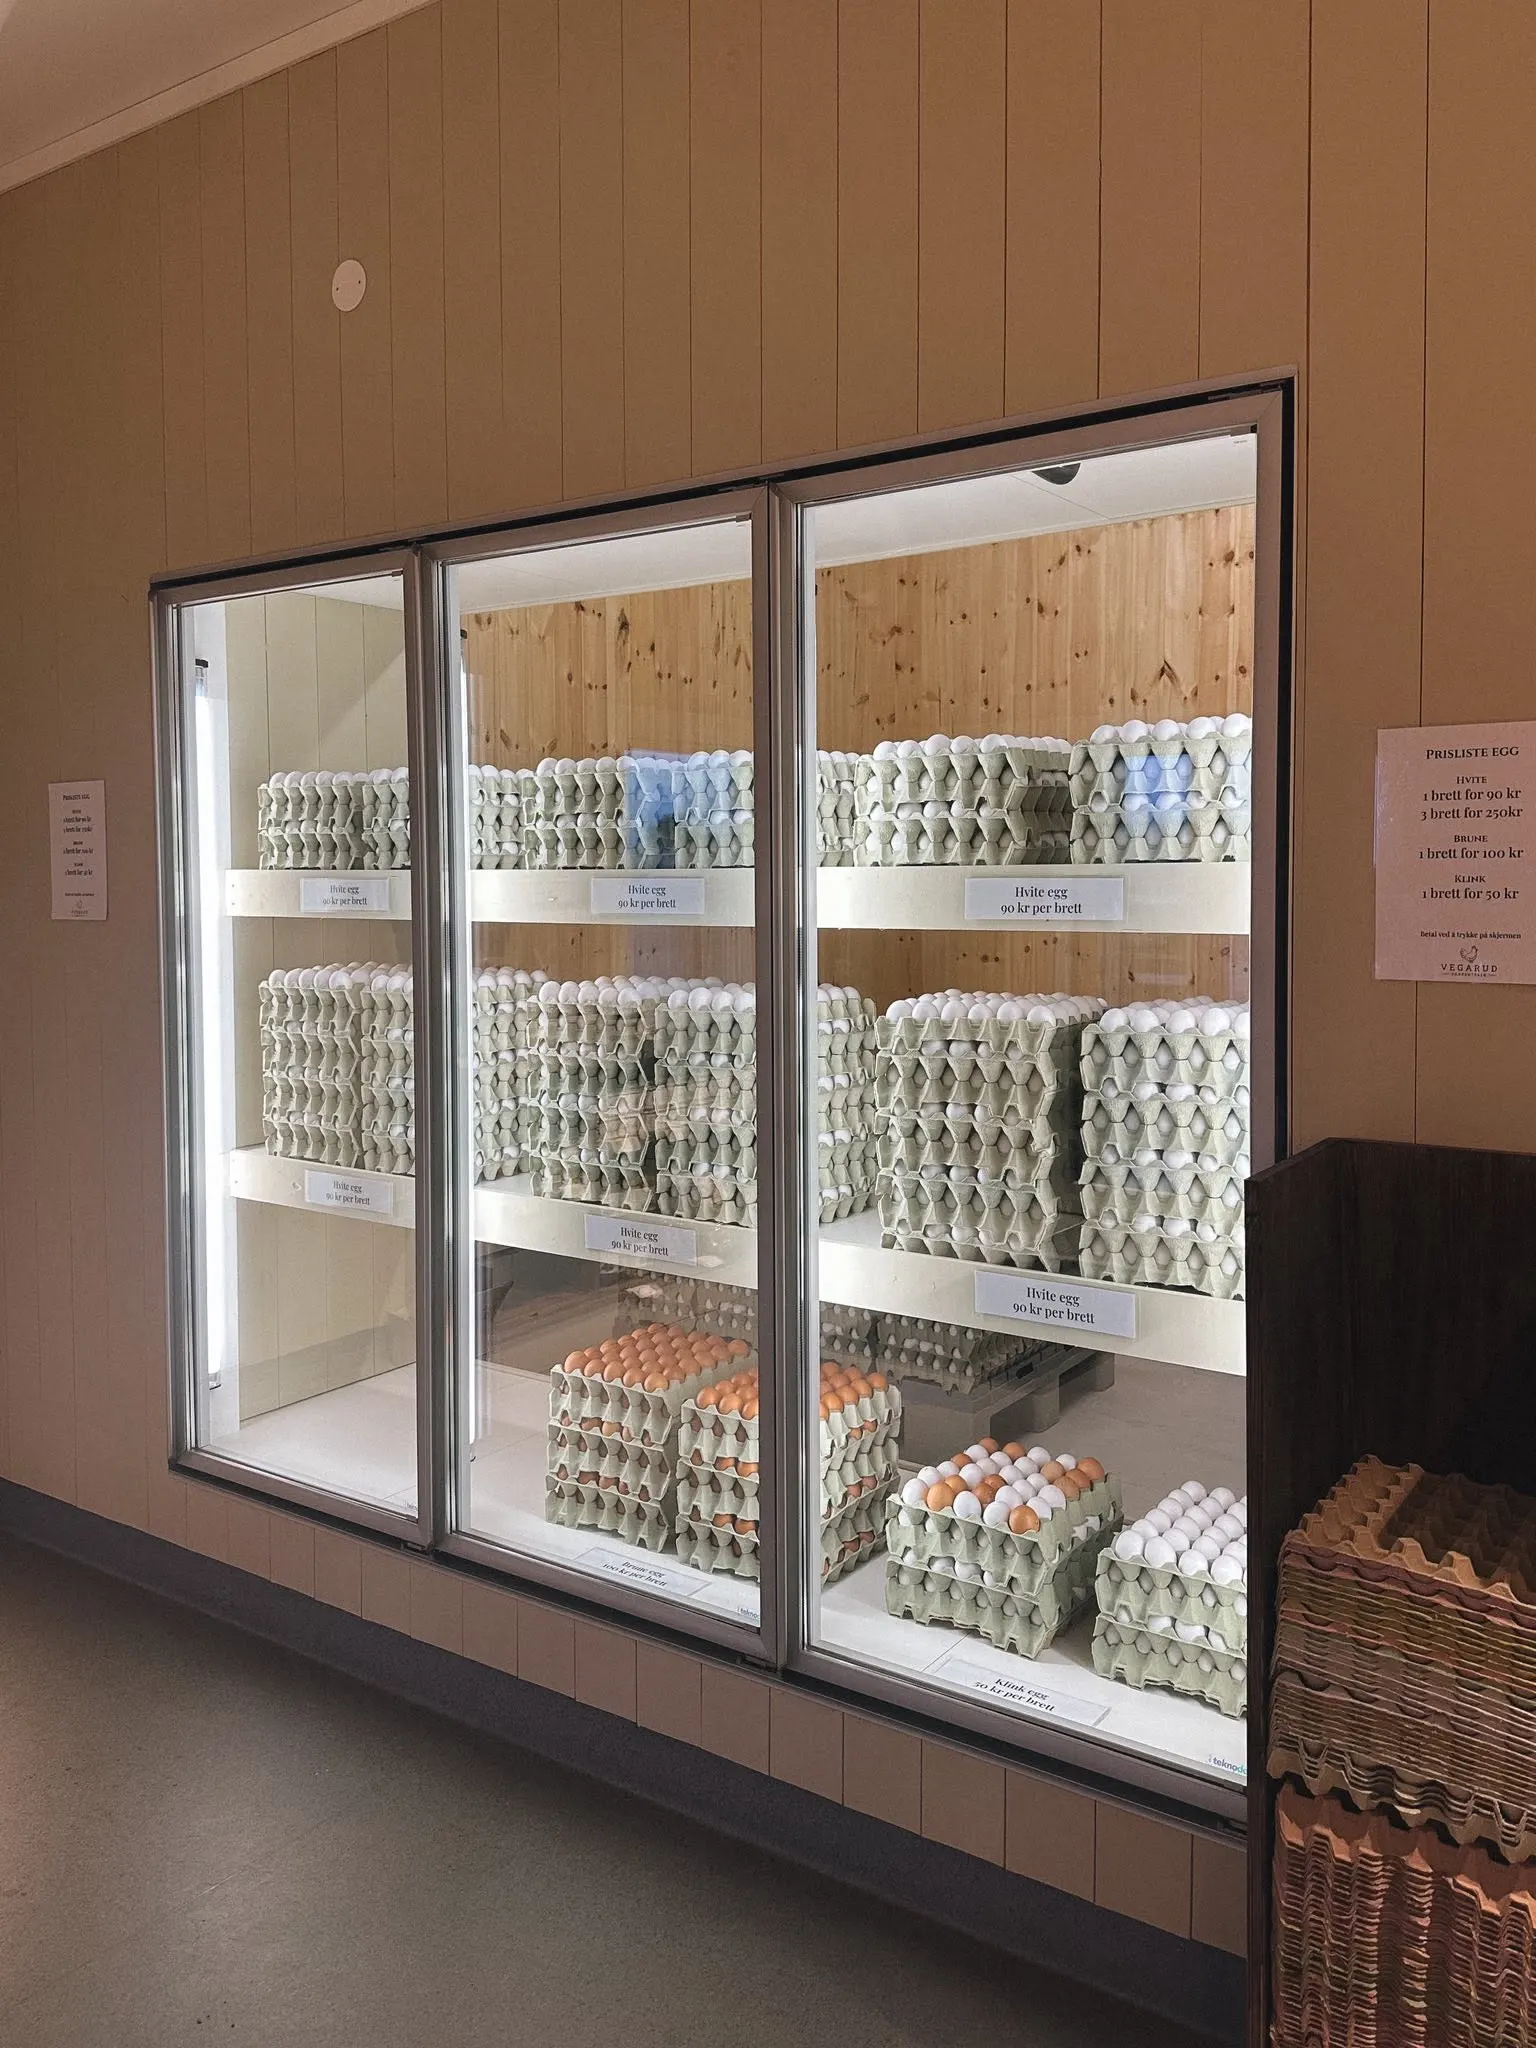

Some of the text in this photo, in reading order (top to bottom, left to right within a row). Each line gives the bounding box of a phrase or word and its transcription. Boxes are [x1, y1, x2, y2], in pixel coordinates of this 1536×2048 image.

[1426, 746, 1519, 759] PRISLISTE EGG
[1456, 776, 1487, 784] HVITE
[1423, 787, 1522, 801] 1 brett for 90 kr
[1420, 805, 1523, 822] 3 brett for 250kr
[1454, 834, 1488, 843] BRUNE
[1419, 846, 1524, 859] 1 brett for 100 kr
[1454, 874, 1487, 883] KLINK
[347, 886, 360, 895] egg
[628, 884, 666, 896] Hvite egg
[1015, 886, 1068, 900] Hvite egg
[1422, 887, 1519, 901] 1 brett for 50 kr
[331, 896, 339, 905] kr
[340, 898, 351, 906] per
[351, 896, 367, 905] brett
[618, 898, 676, 909] 90 kr per brett
[1000, 902, 1082, 915] 90 kr per brett
[1489, 932, 1521, 940] skjermen
[1441, 964, 1498, 973] VEGARUD
[350, 1185, 362, 1193] egg
[335, 1191, 342, 1202] kr
[342, 1195, 354, 1204] per
[354, 1194, 370, 1205] brett
[621, 1227, 659, 1242] Hvite egg
[611, 1240, 669, 1256] 90 kr per brett
[1026, 1287, 1080, 1307] Hvite egg
[1013, 1302, 1095, 1324] 90 kr per brett
[995, 1678, 1050, 1701] Klink egg
[973, 1681, 1056, 1712] 50 kr per brett
